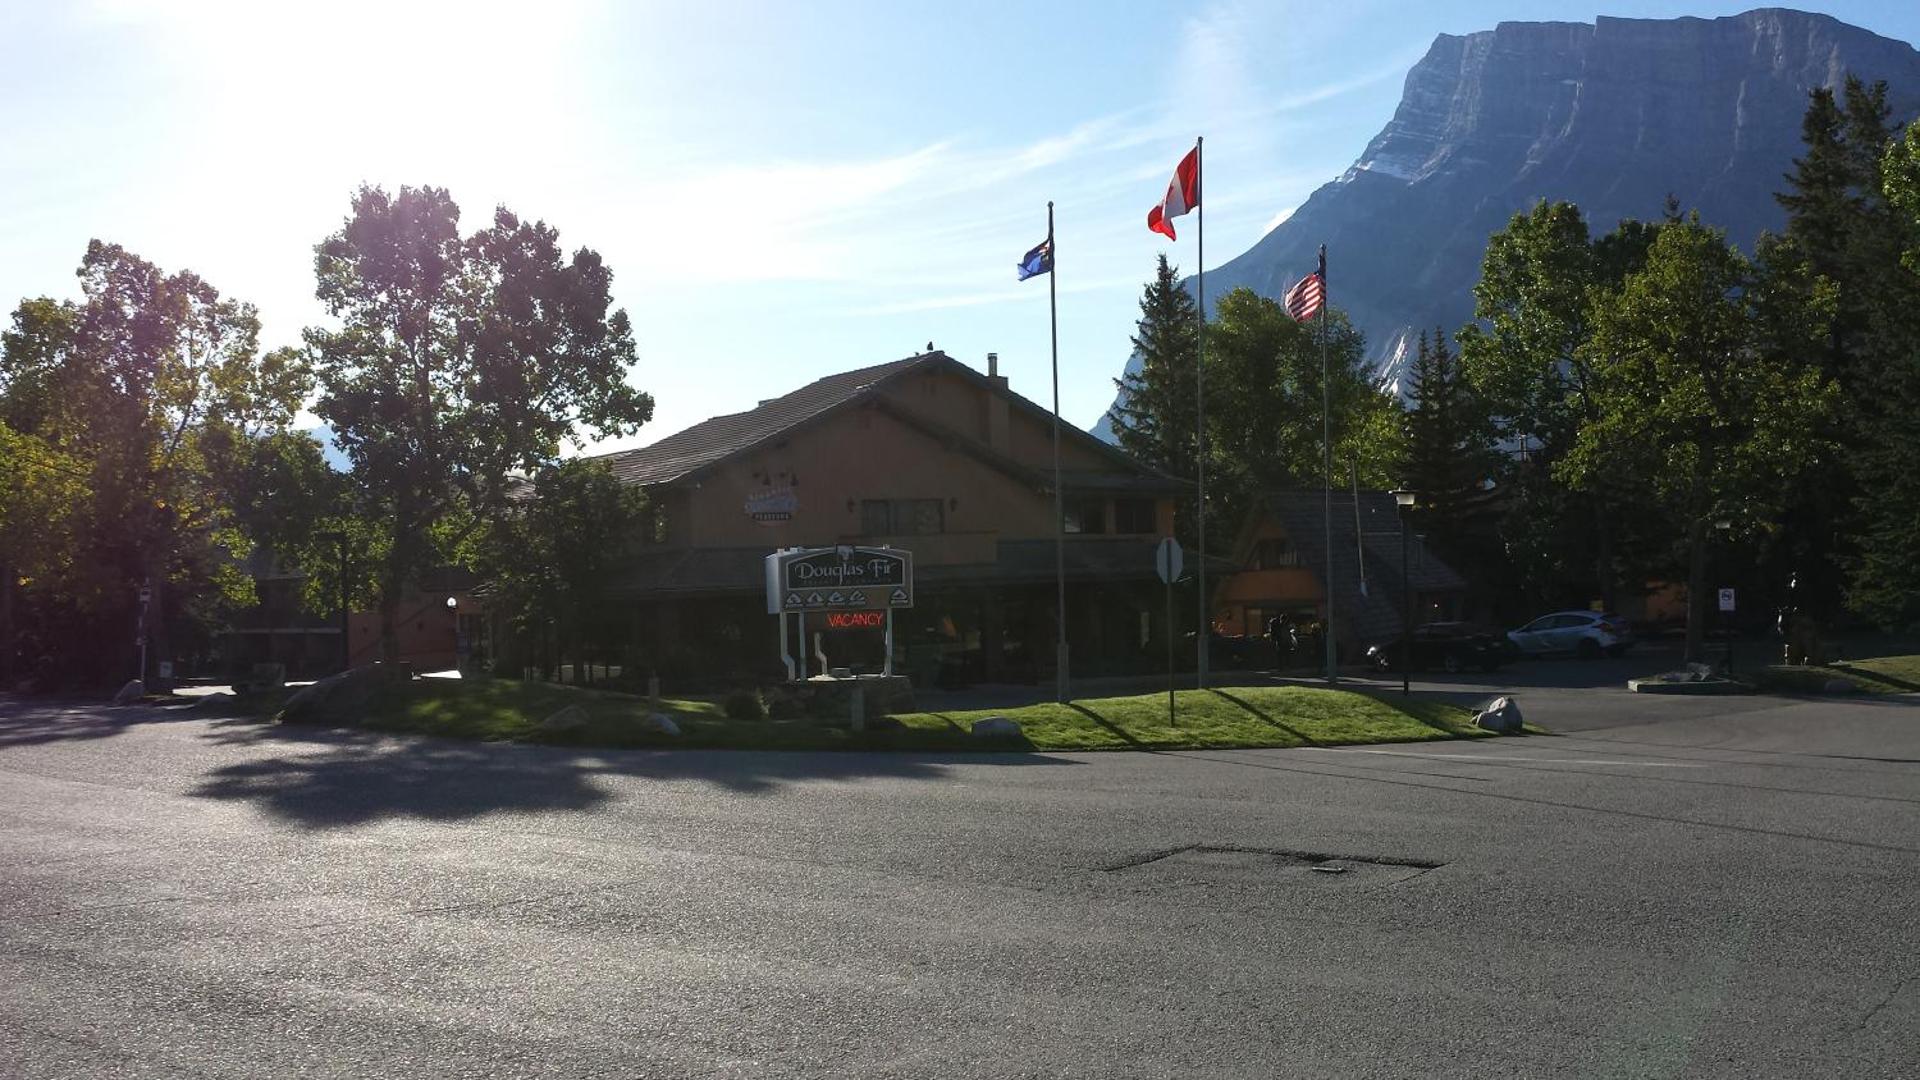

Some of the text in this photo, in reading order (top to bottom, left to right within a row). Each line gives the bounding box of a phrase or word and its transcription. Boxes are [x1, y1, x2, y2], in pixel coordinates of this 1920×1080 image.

[795, 562, 864, 585] Douglas
[867, 558, 897, 578] Fir
[828, 613, 883, 627] VACANCY
